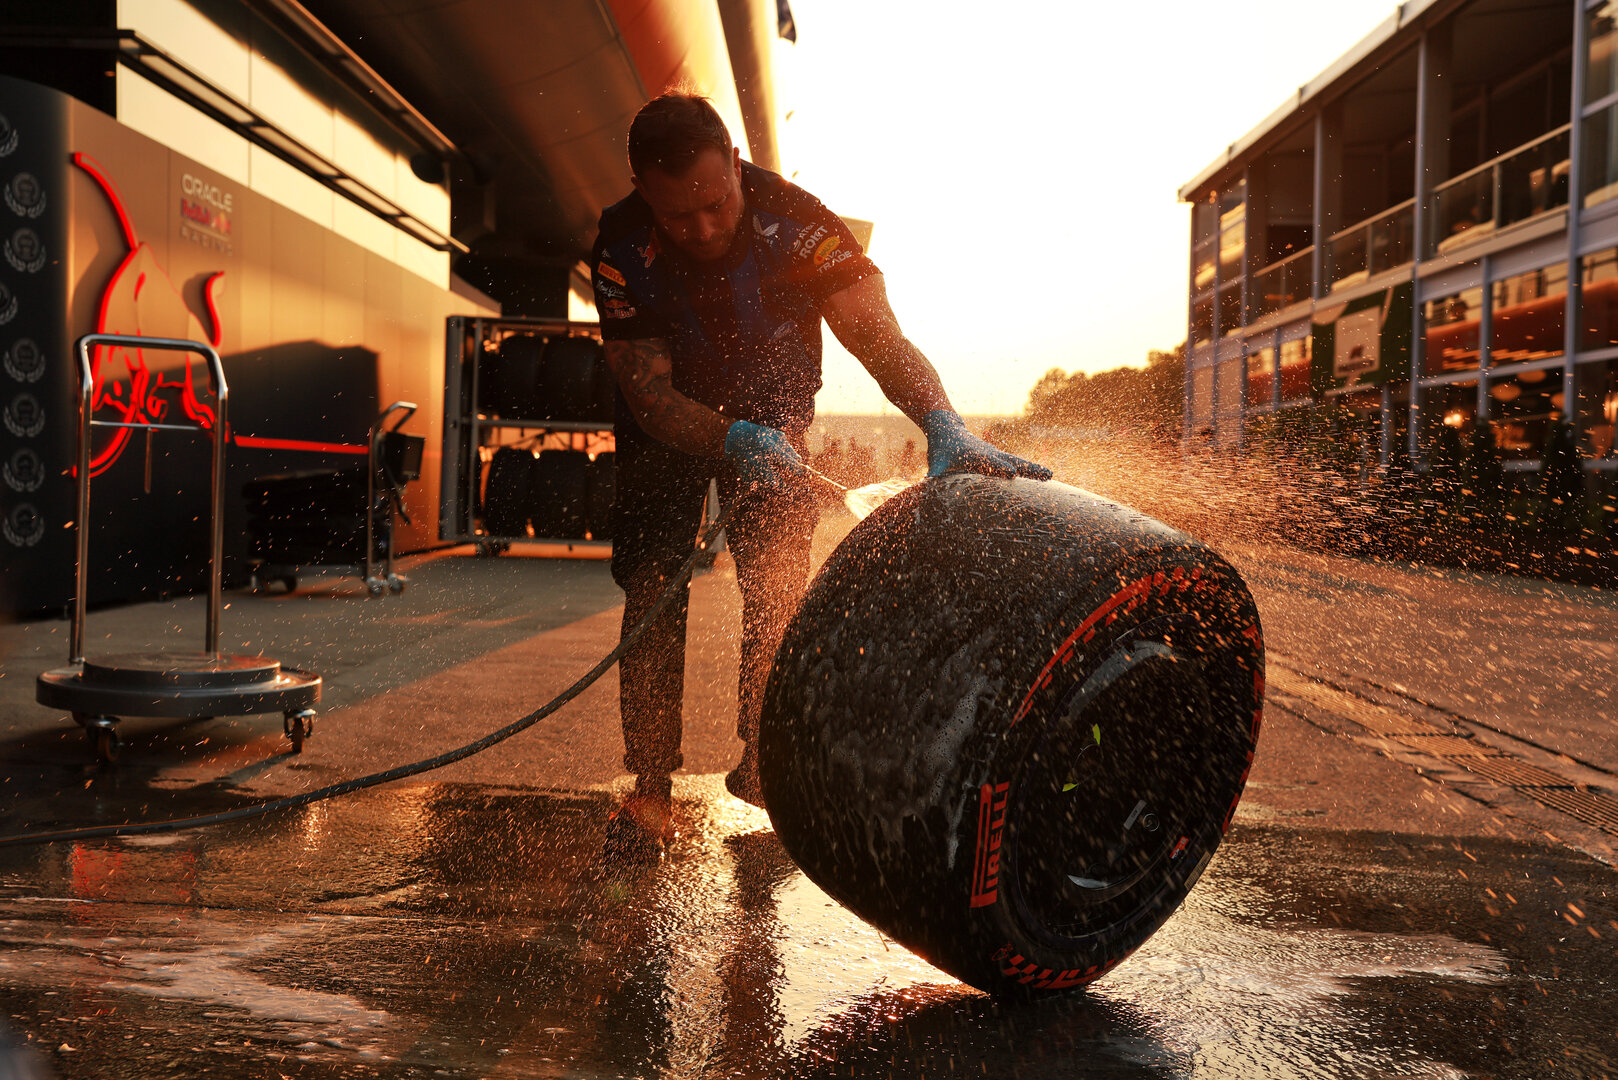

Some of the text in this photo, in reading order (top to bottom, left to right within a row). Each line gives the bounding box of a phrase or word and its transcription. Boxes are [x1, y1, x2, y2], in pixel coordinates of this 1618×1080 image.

[182, 174, 232, 212] ORACLE
[799, 226, 828, 258] ROKT
[818, 250, 853, 274] TRADE
[969, 781, 1010, 908] PIRELLI
